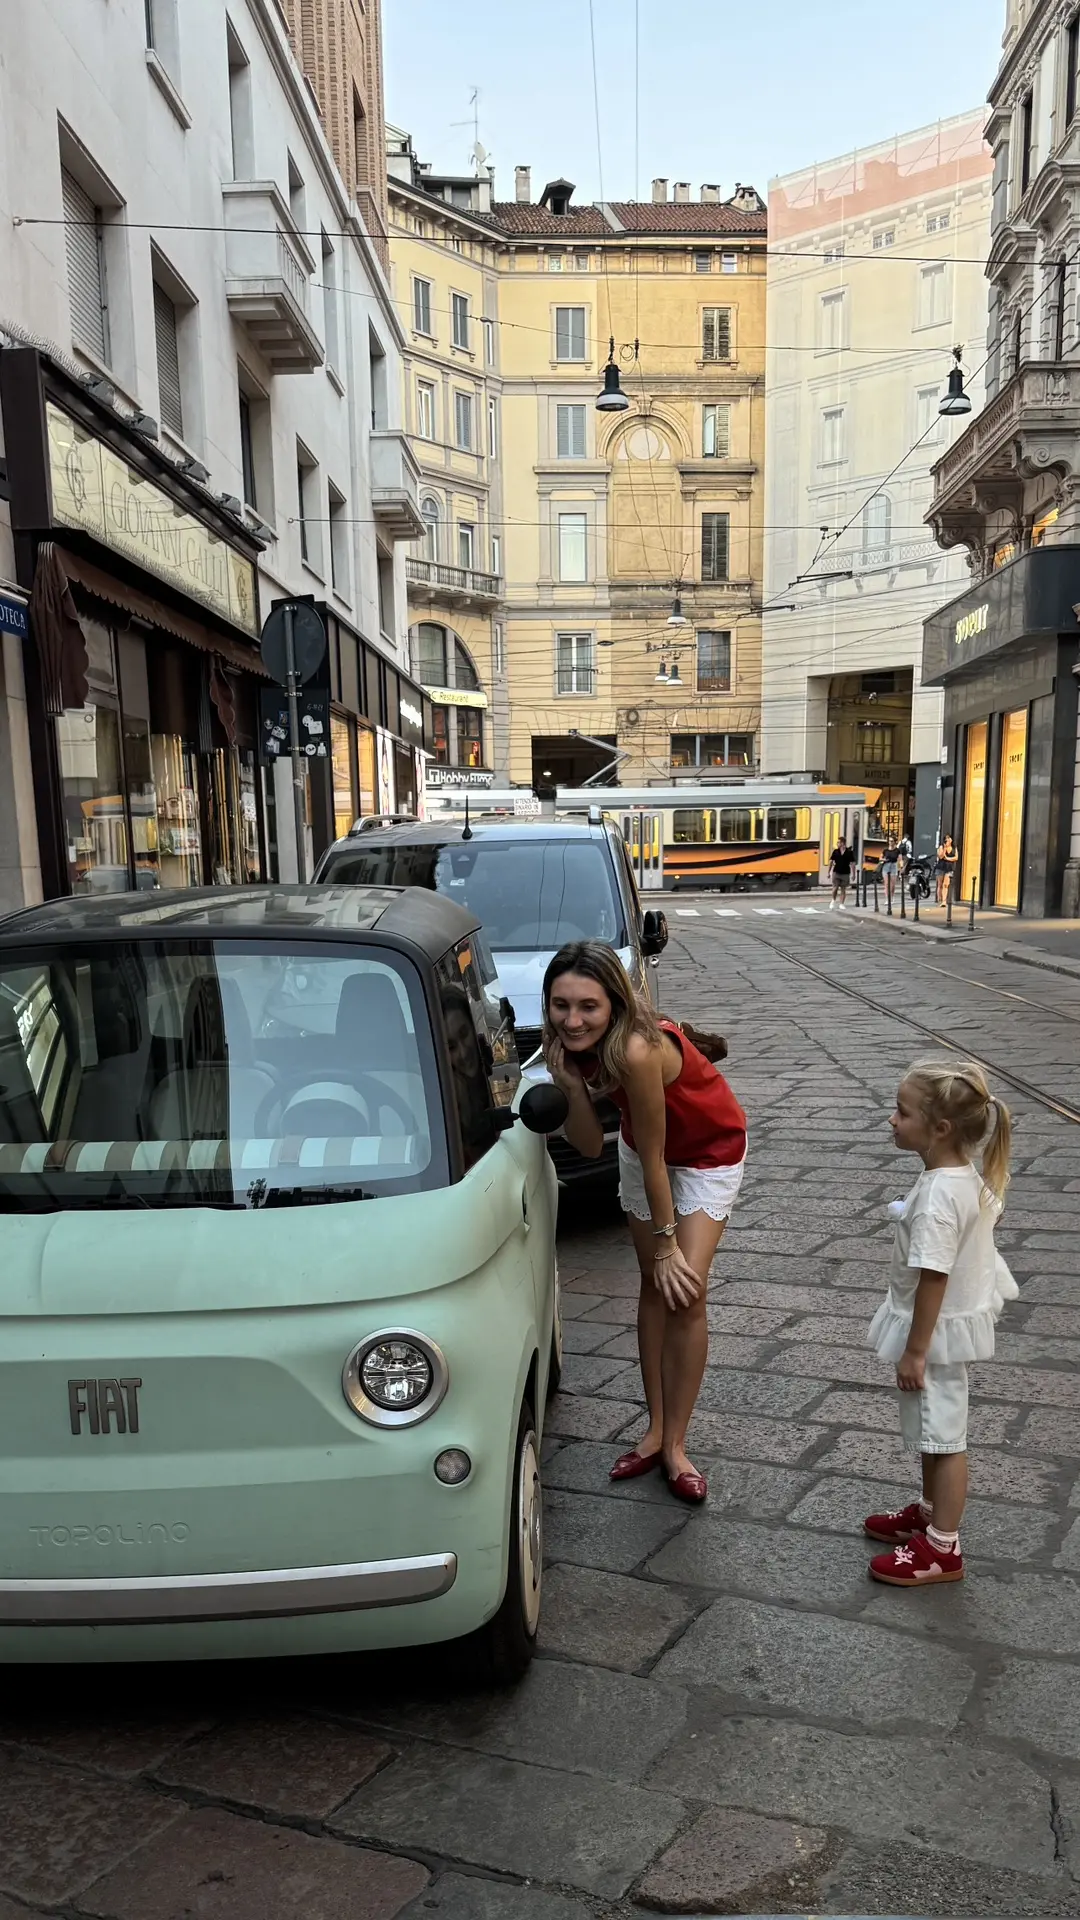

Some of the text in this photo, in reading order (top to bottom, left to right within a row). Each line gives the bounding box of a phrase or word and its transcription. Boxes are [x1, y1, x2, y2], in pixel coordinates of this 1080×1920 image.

[111, 481, 224, 596] GIOVANNI GALLI
[67, 1377, 143, 1436] FIAT
